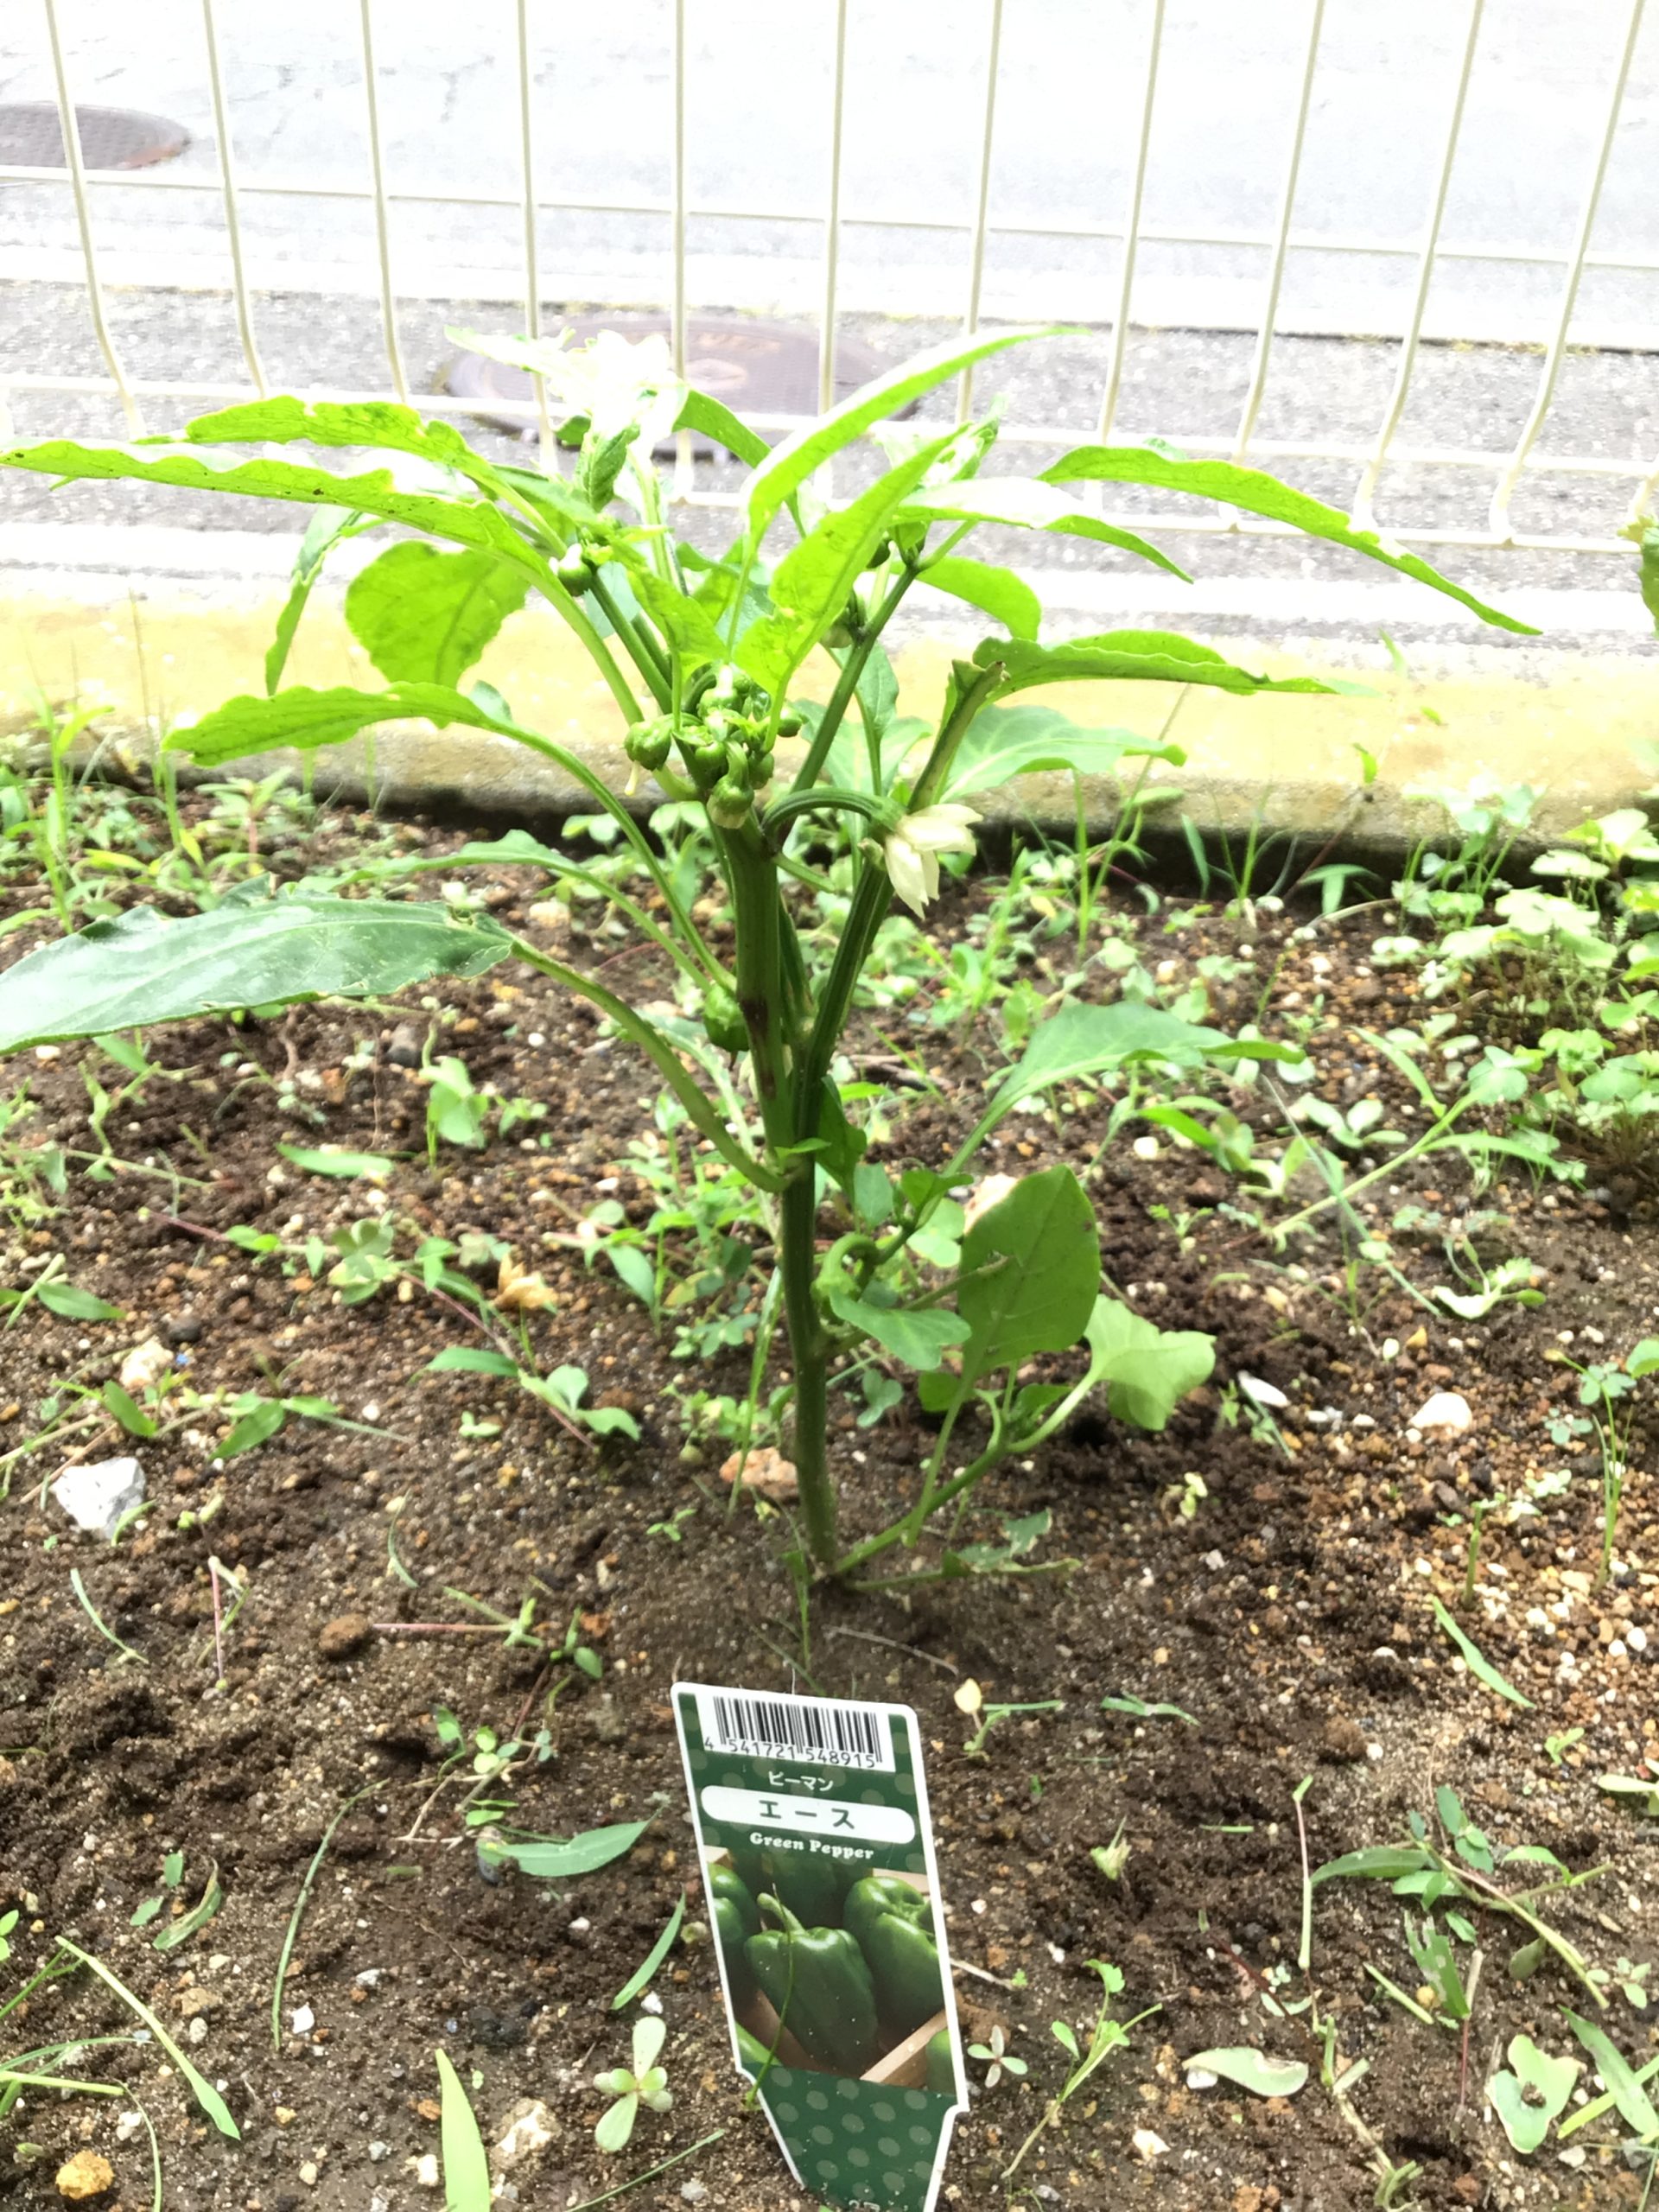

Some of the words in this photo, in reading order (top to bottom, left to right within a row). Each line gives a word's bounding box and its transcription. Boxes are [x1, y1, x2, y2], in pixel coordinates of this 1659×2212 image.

[704, 1737, 715, 1750] 4
[728, 1738, 796, 1759] 541721
[805, 1749, 875, 1768] 548915
[768, 1770, 834, 1792] ピーマン
[759, 1799, 855, 1830] エース
[749, 1831, 804, 1851] Green
[810, 1840, 874, 1860] Pepper
